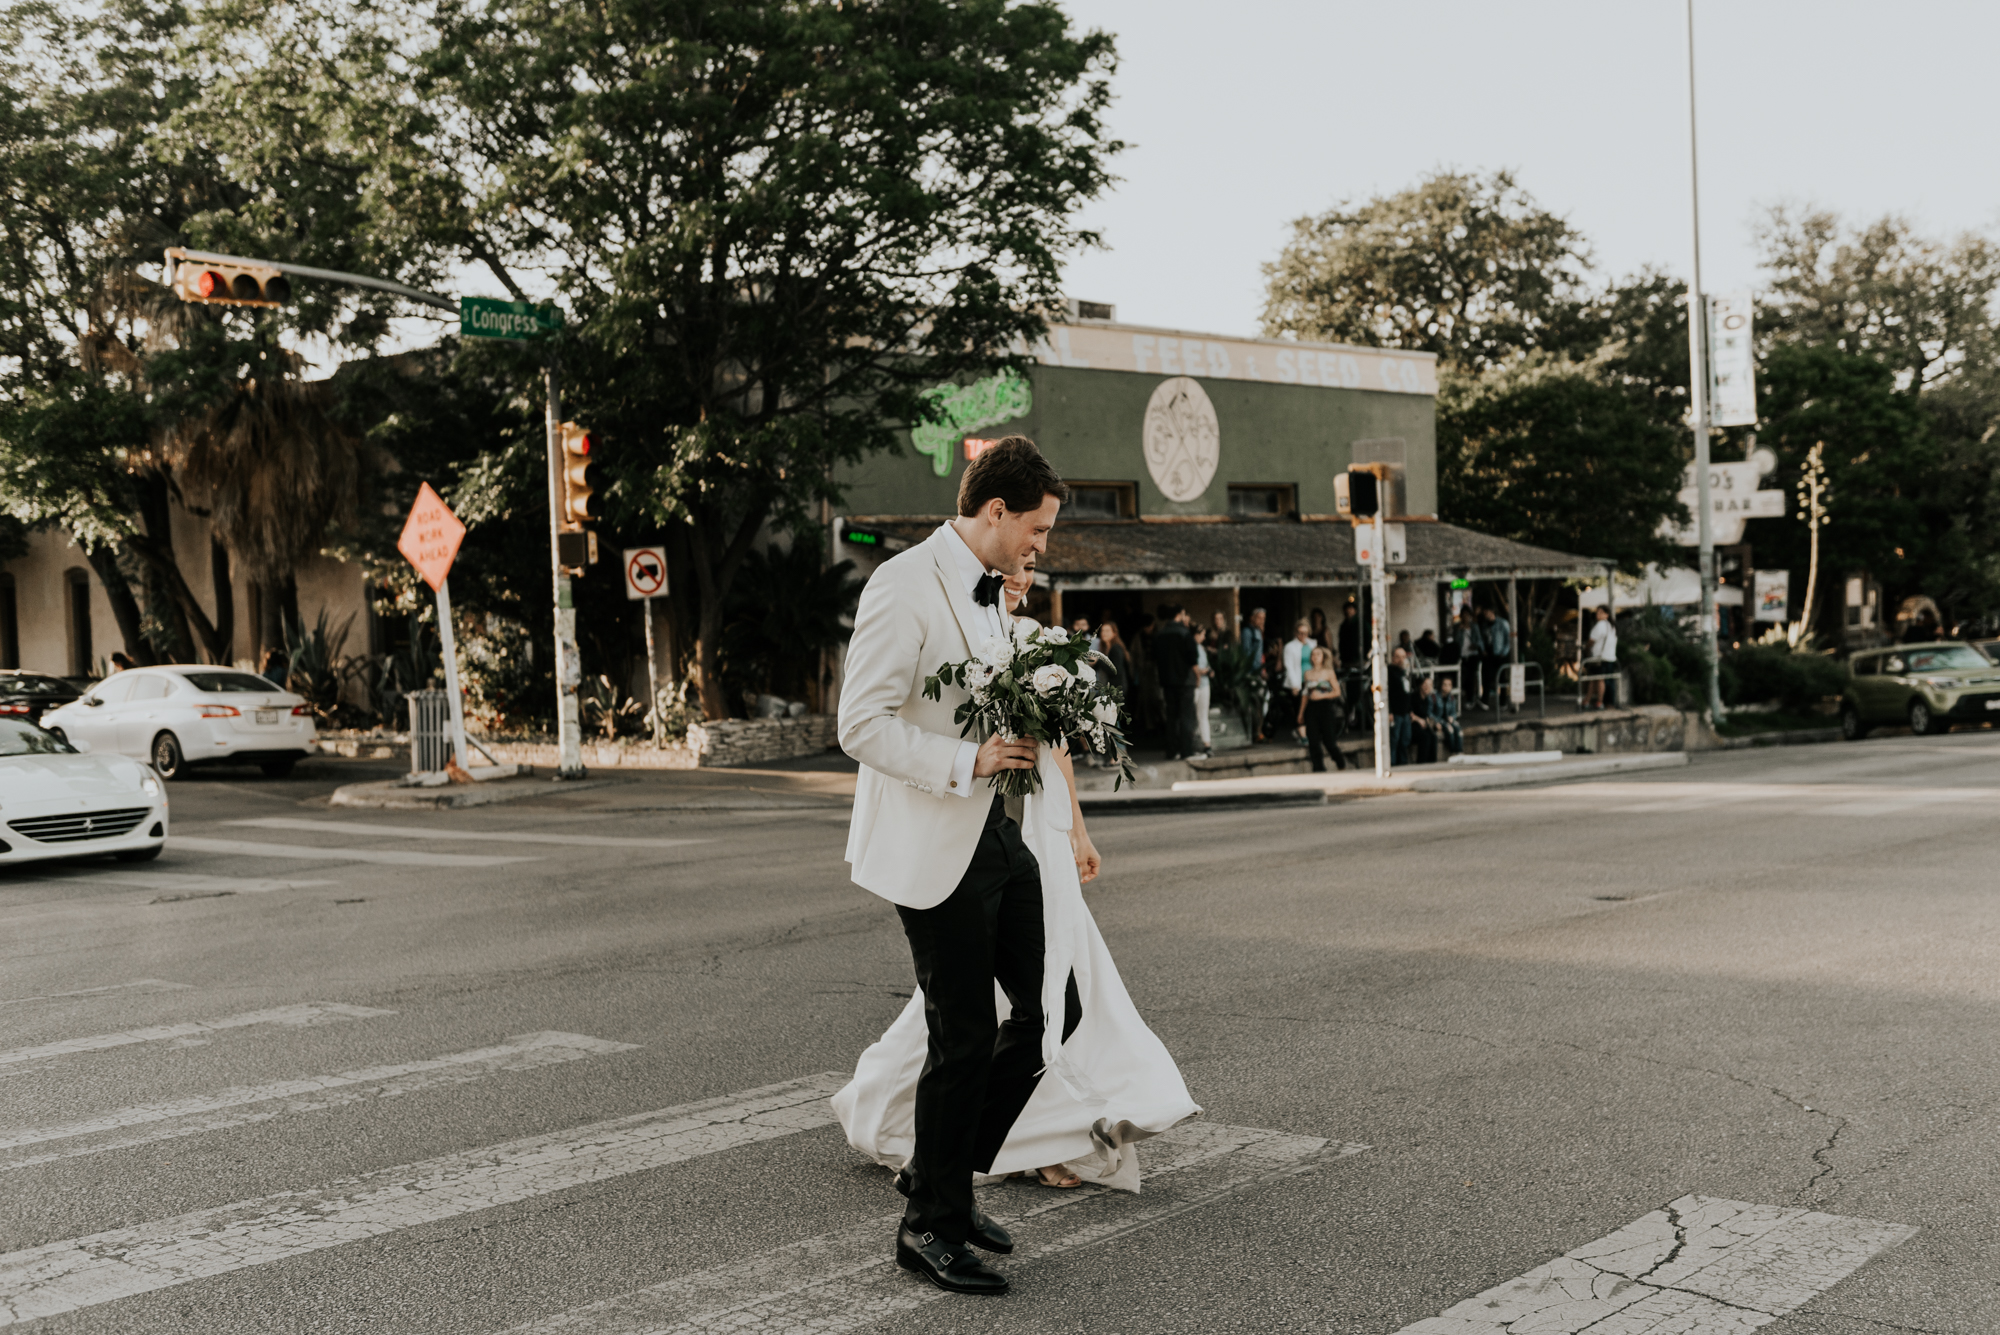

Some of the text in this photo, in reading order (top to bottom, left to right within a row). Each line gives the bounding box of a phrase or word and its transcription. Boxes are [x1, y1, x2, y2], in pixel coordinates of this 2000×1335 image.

[472, 304, 539, 336] Congress
[1132, 334, 1232, 378] FEED
[1276, 349, 1361, 388] SEED
[417, 507, 442, 525] ROAD
[420, 528, 444, 543] WORK
[420, 545, 449, 561] AHEAD
